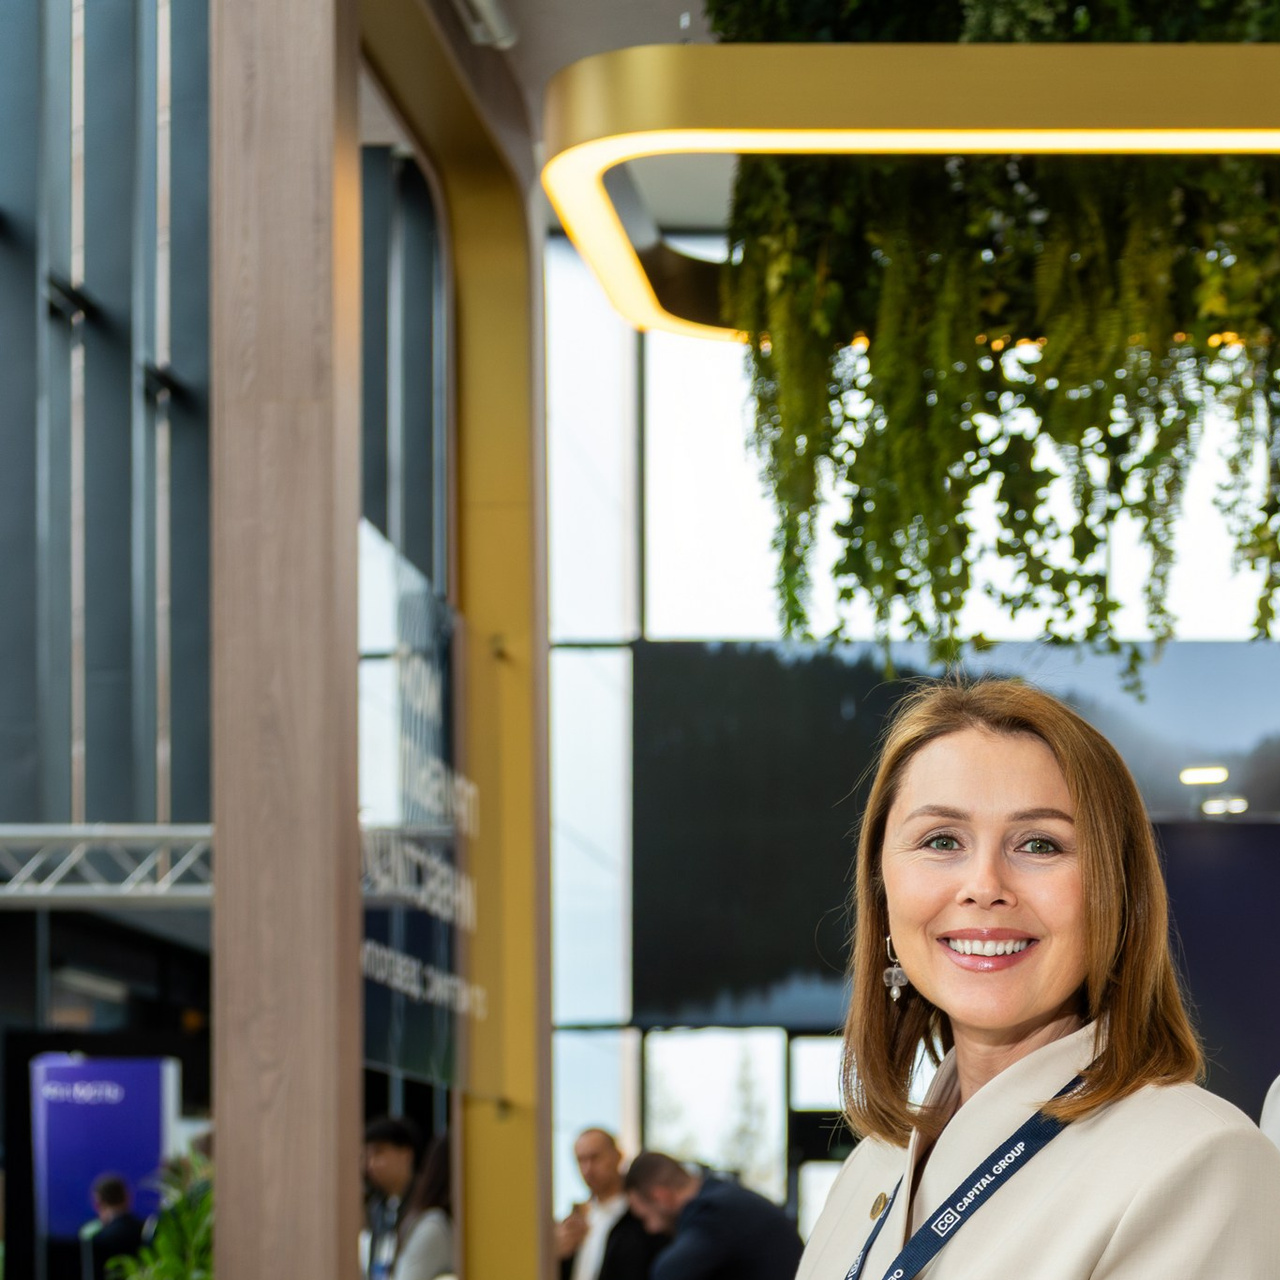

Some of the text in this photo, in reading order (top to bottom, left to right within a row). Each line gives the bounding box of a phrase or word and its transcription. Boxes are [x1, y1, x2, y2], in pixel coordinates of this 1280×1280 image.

[934, 1141, 1026, 1234] CG CAPITAL GROUP
